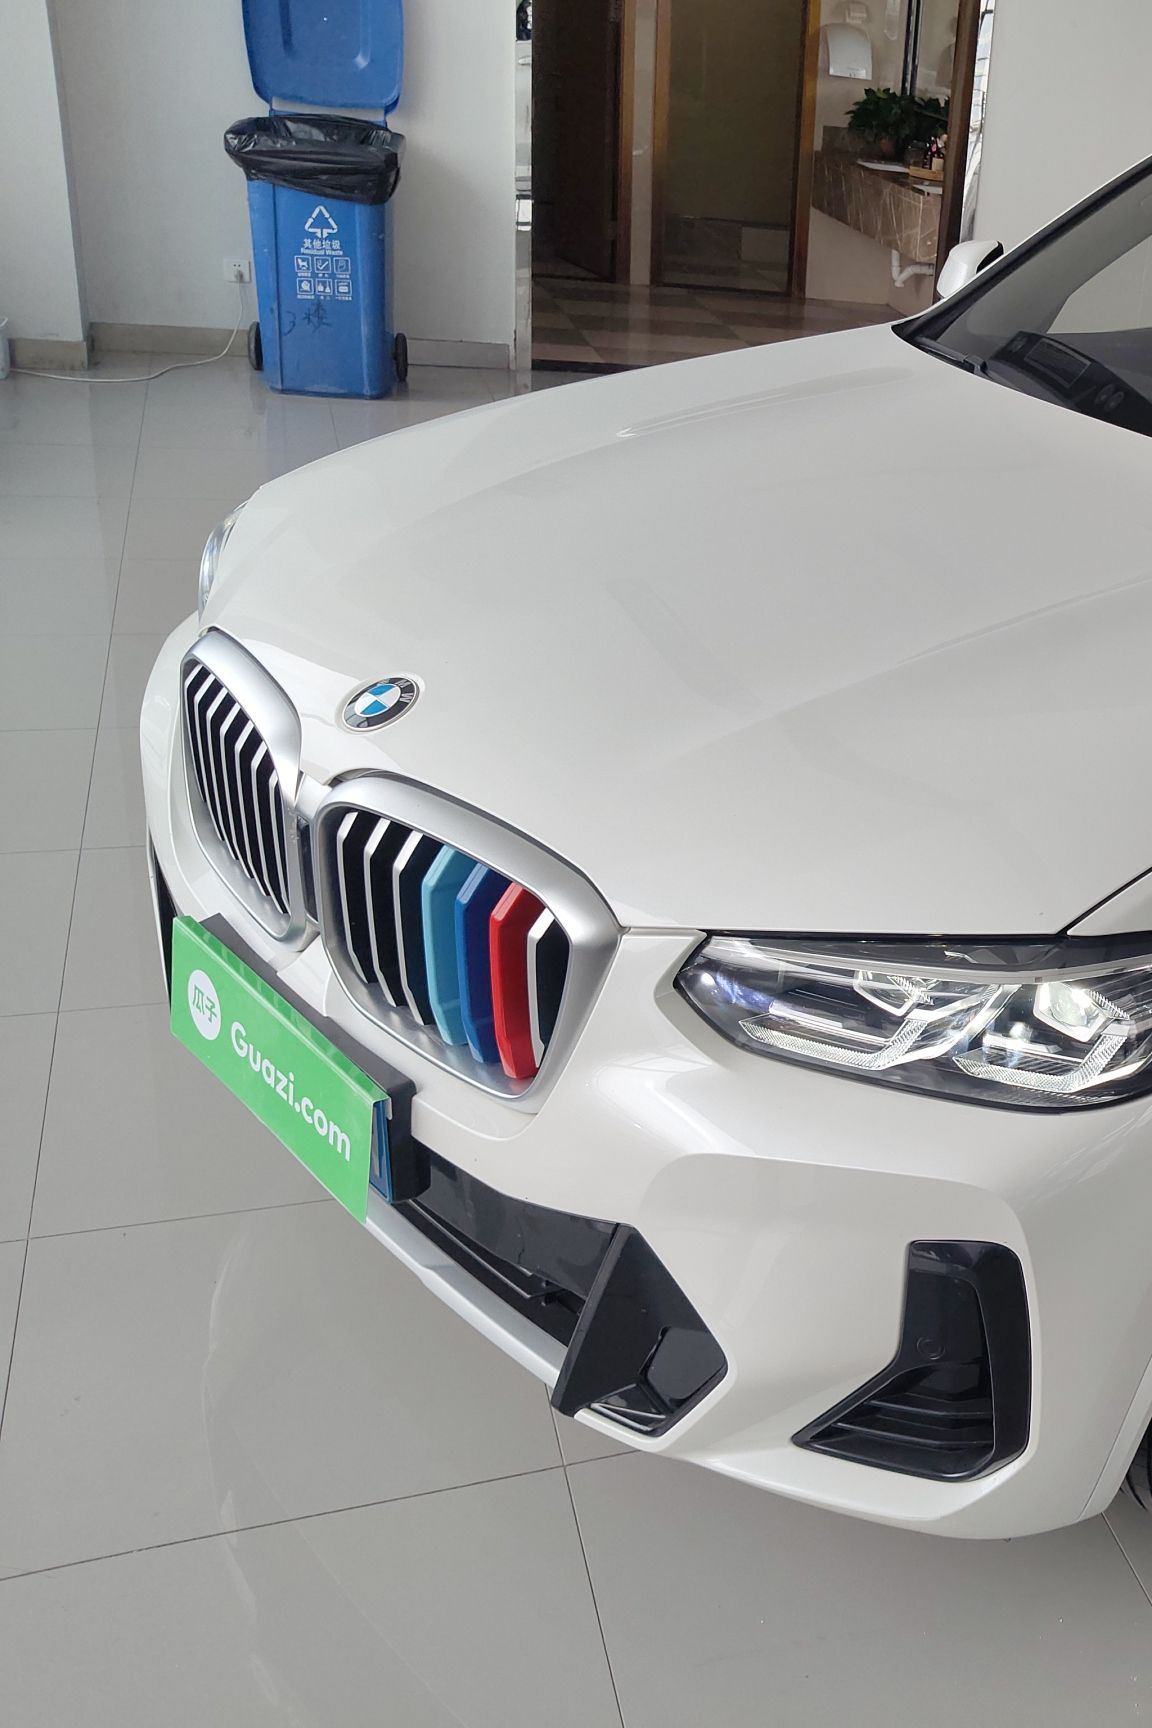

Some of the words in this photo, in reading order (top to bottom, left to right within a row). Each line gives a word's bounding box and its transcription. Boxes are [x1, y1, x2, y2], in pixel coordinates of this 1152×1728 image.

[303, 238, 341, 249] 其他垃圾
[192, 984, 218, 1023] 瓜子
[231, 1021, 351, 1162] Guazi.com
